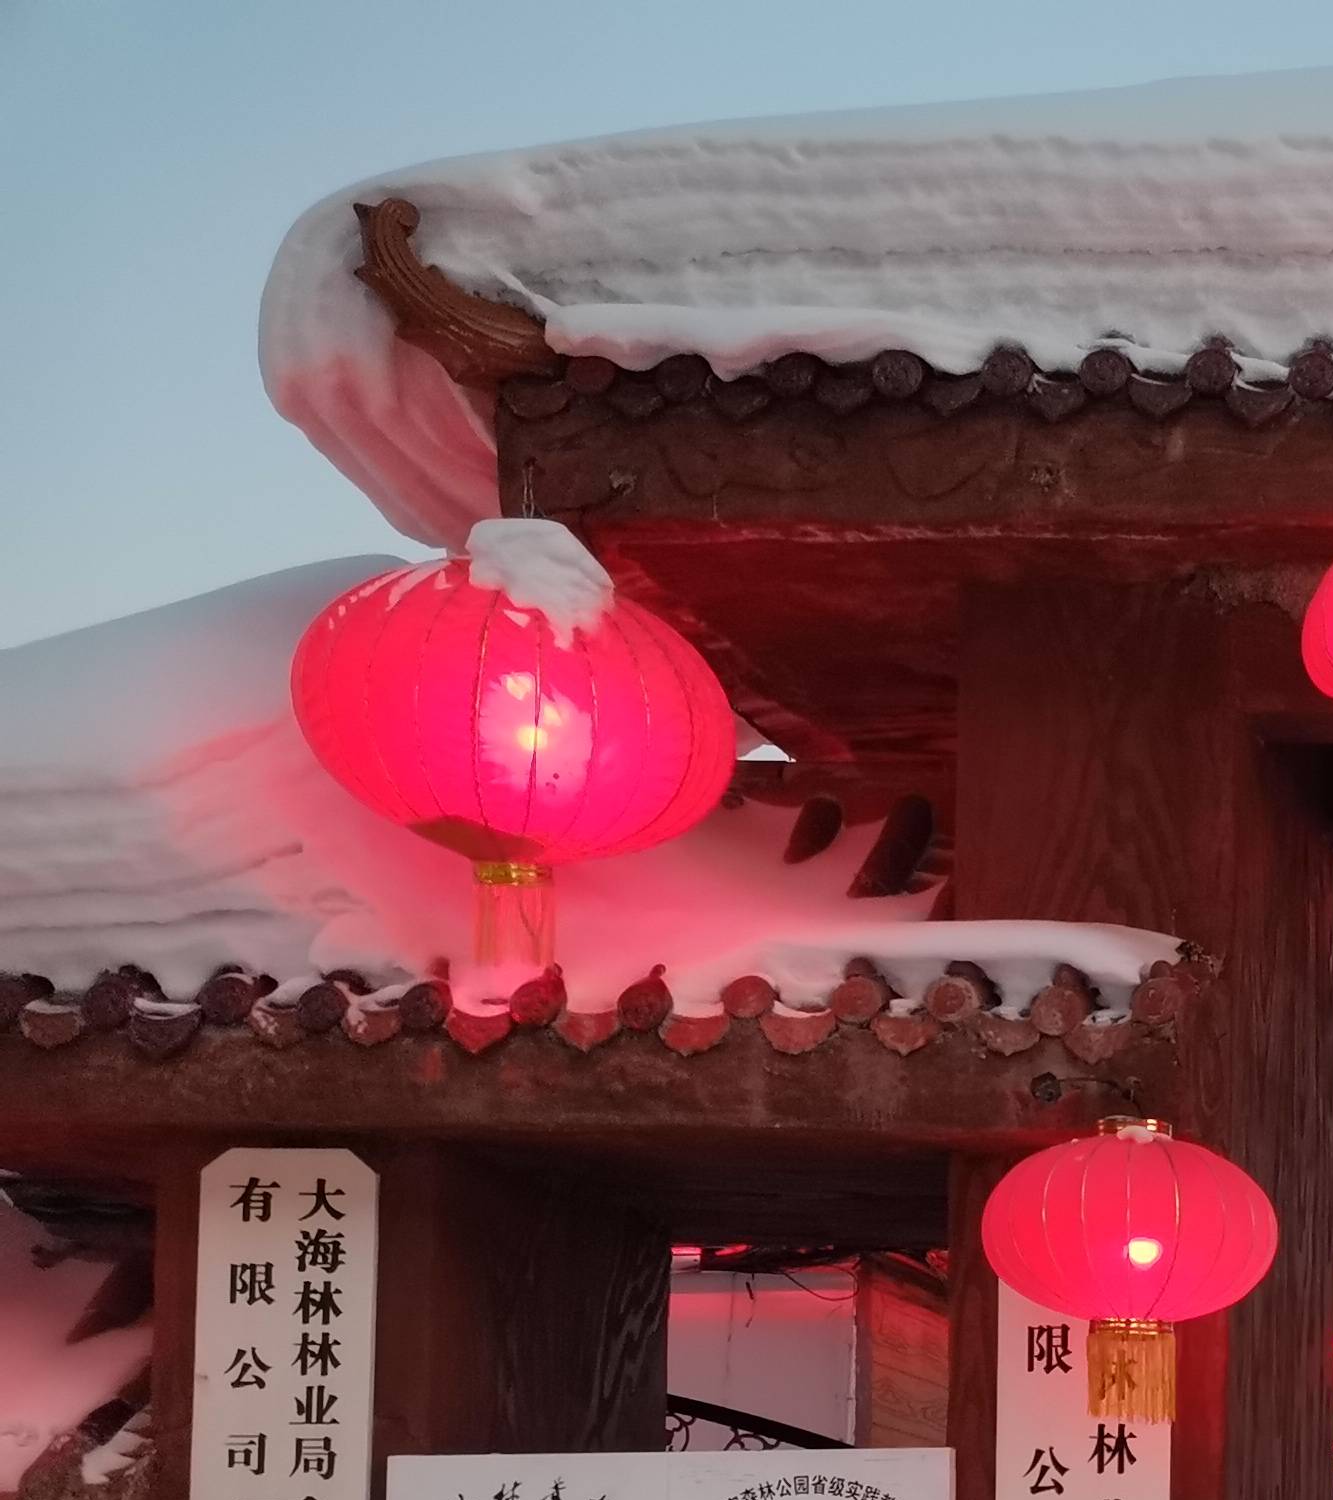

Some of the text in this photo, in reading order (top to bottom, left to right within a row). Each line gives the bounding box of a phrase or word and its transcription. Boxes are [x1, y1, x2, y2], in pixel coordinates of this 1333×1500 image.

[224, 1177, 281, 1475] 有限公司
[288, 1177, 347, 1480] 大海林林业局
